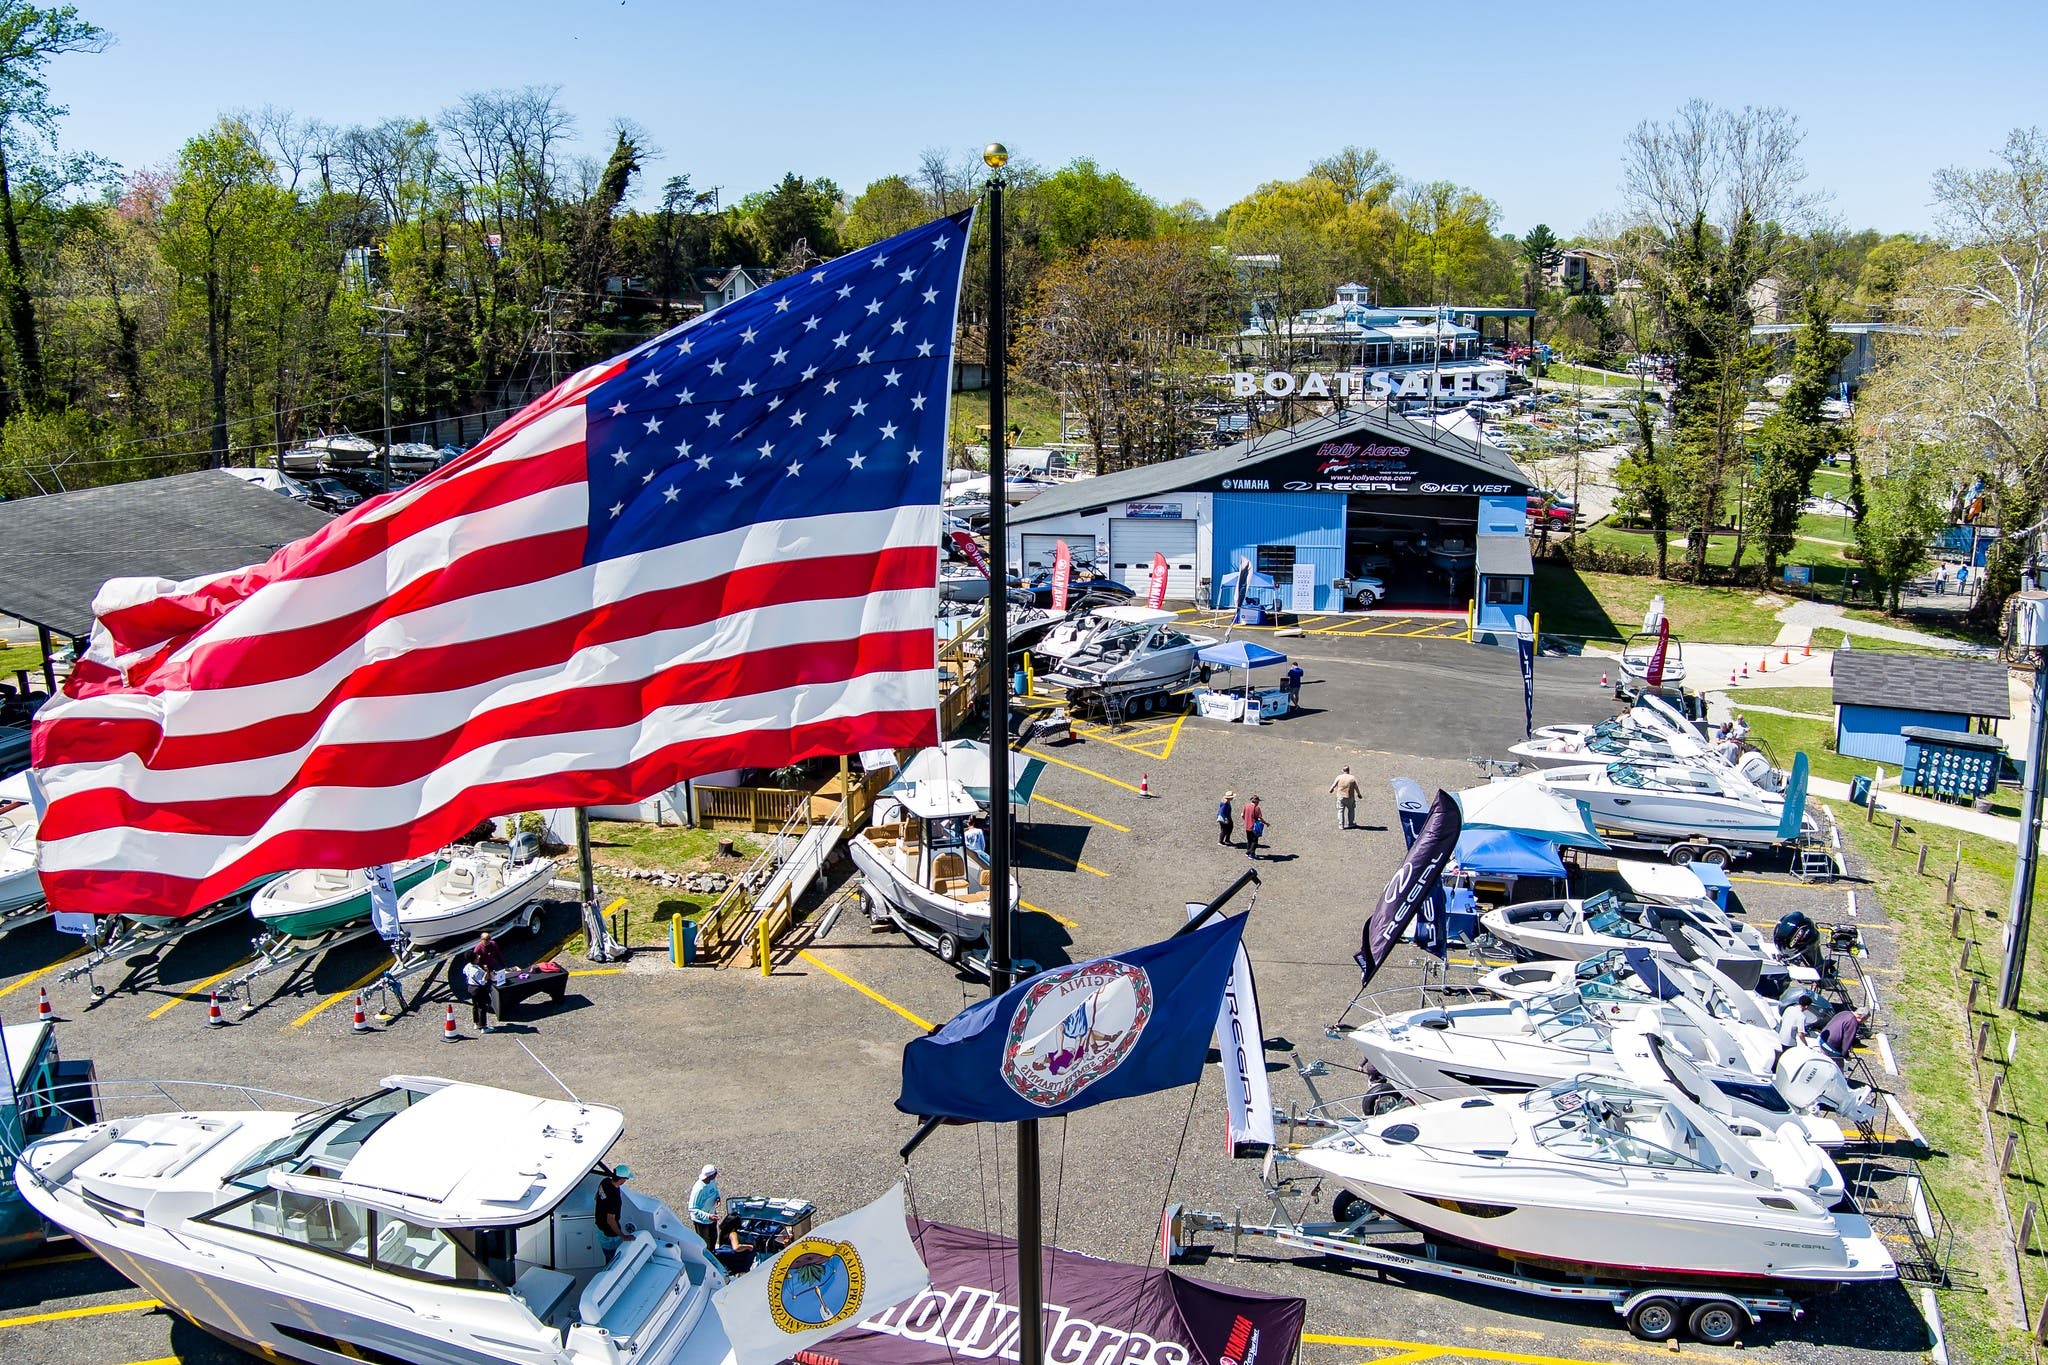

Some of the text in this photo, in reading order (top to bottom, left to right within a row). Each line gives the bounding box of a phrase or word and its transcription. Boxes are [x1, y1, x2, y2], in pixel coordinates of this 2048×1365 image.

[1234, 372, 1500, 397] BOAT SALES
[1317, 443, 1411, 458] Holly Acres
[1232, 480, 1269, 490] YAMAHA
[1316, 482, 1409, 491] REGAL
[1440, 484, 1511, 493] KEY WEST
[1053, 571, 1066, 607] YAMAHA
[1149, 577, 1163, 609] YAMAH
[1383, 852, 1444, 940] REGAL
[1225, 992, 1254, 1130] REGAL
[851, 1271, 859, 1286] OF
[1223, 1314, 1253, 1361] YAMAHA
[796, 1351, 840, 1365] YAMAHA
